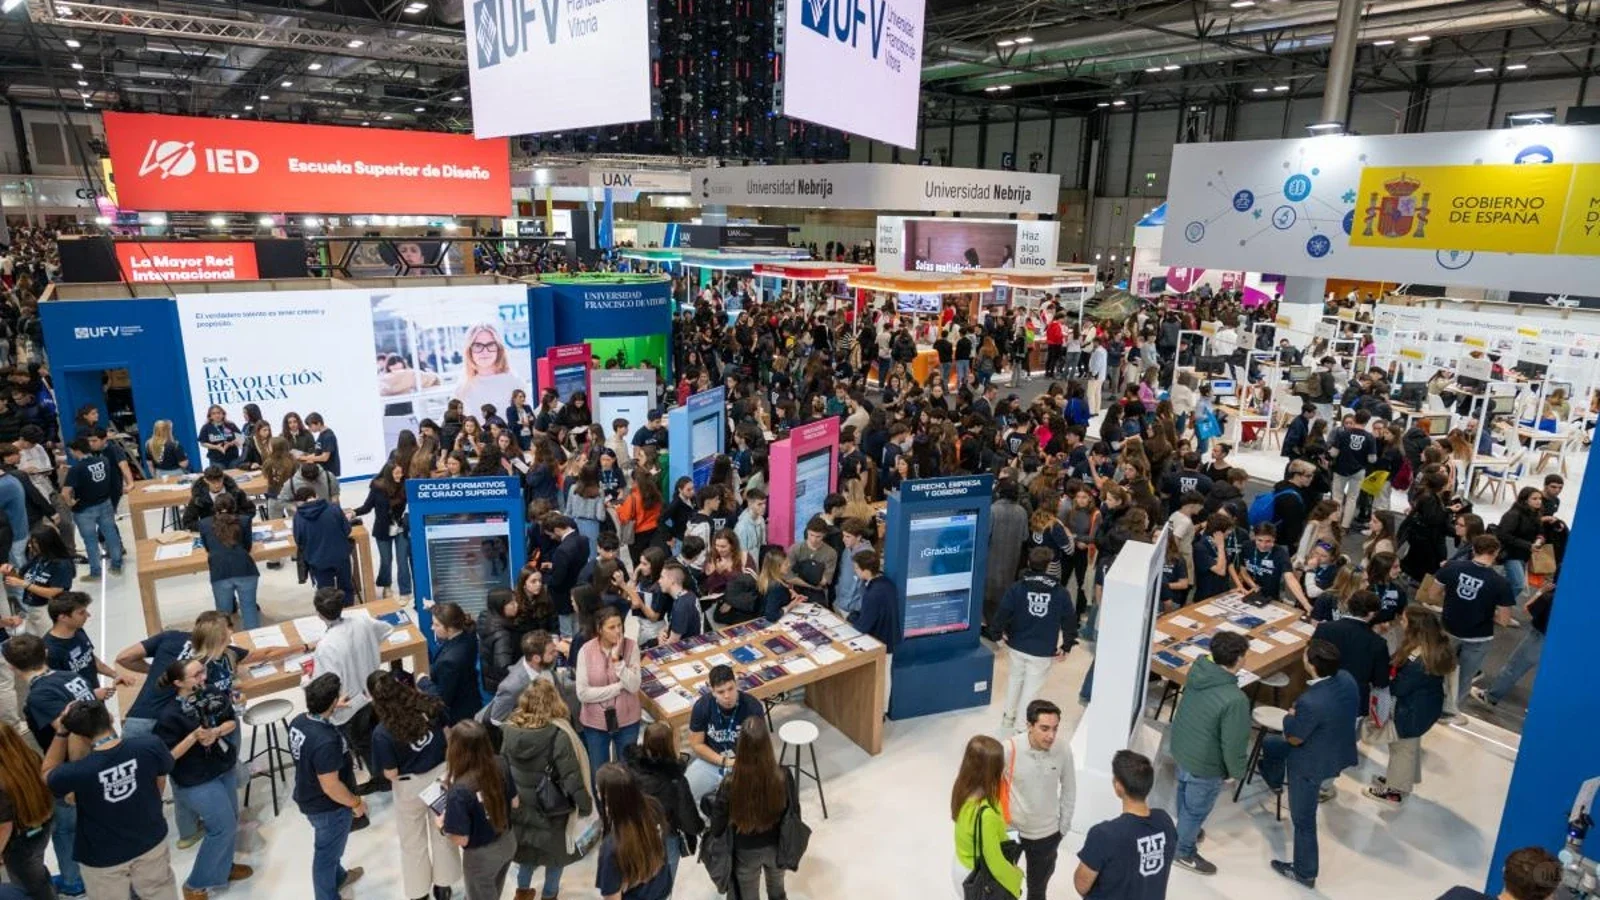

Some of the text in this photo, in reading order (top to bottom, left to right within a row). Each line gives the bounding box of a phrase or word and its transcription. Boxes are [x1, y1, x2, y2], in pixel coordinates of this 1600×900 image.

[500, 0, 559, 57] UFV
[567, 13, 598, 38] Vitoria
[833, 0, 886, 59] UFV
[205, 148, 259, 174] IED
[288, 158, 490, 180] Escuela Superior de Diseño
[602, 172, 633, 187] UAX
[746, 178, 833, 199] Universidad Nebrija
[925, 181, 1032, 204] Universidad Nebrija
[1452, 196, 1545, 209] GOBIERNO
[1449, 209, 1540, 224] DE ESPAÑA
[1022, 230, 1039, 241] Haz
[1020, 243, 1040, 254] algo
[130, 255, 234, 269] La Mayor Red
[915, 260, 934, 271] Salas
[1019, 254, 1046, 266] único
[132, 268, 235, 281] Internacional
[584, 291, 642, 300] UNIVERSIDAD
[584, 300, 634, 309] FRANCISCO
[89, 326, 119, 338] UFV
[205, 366, 229, 379] LA
[206, 369, 323, 392] REVOLUCIÓN
[208, 387, 288, 405] HUMANA
[419, 481, 506, 491] CICLOS FORMATIVOS
[911, 480, 981, 491] DERECHO, EMPRESA
[417, 488, 508, 499] DE GRADO SUPERIOR
[920, 545, 960, 558] ¡Gracias!
